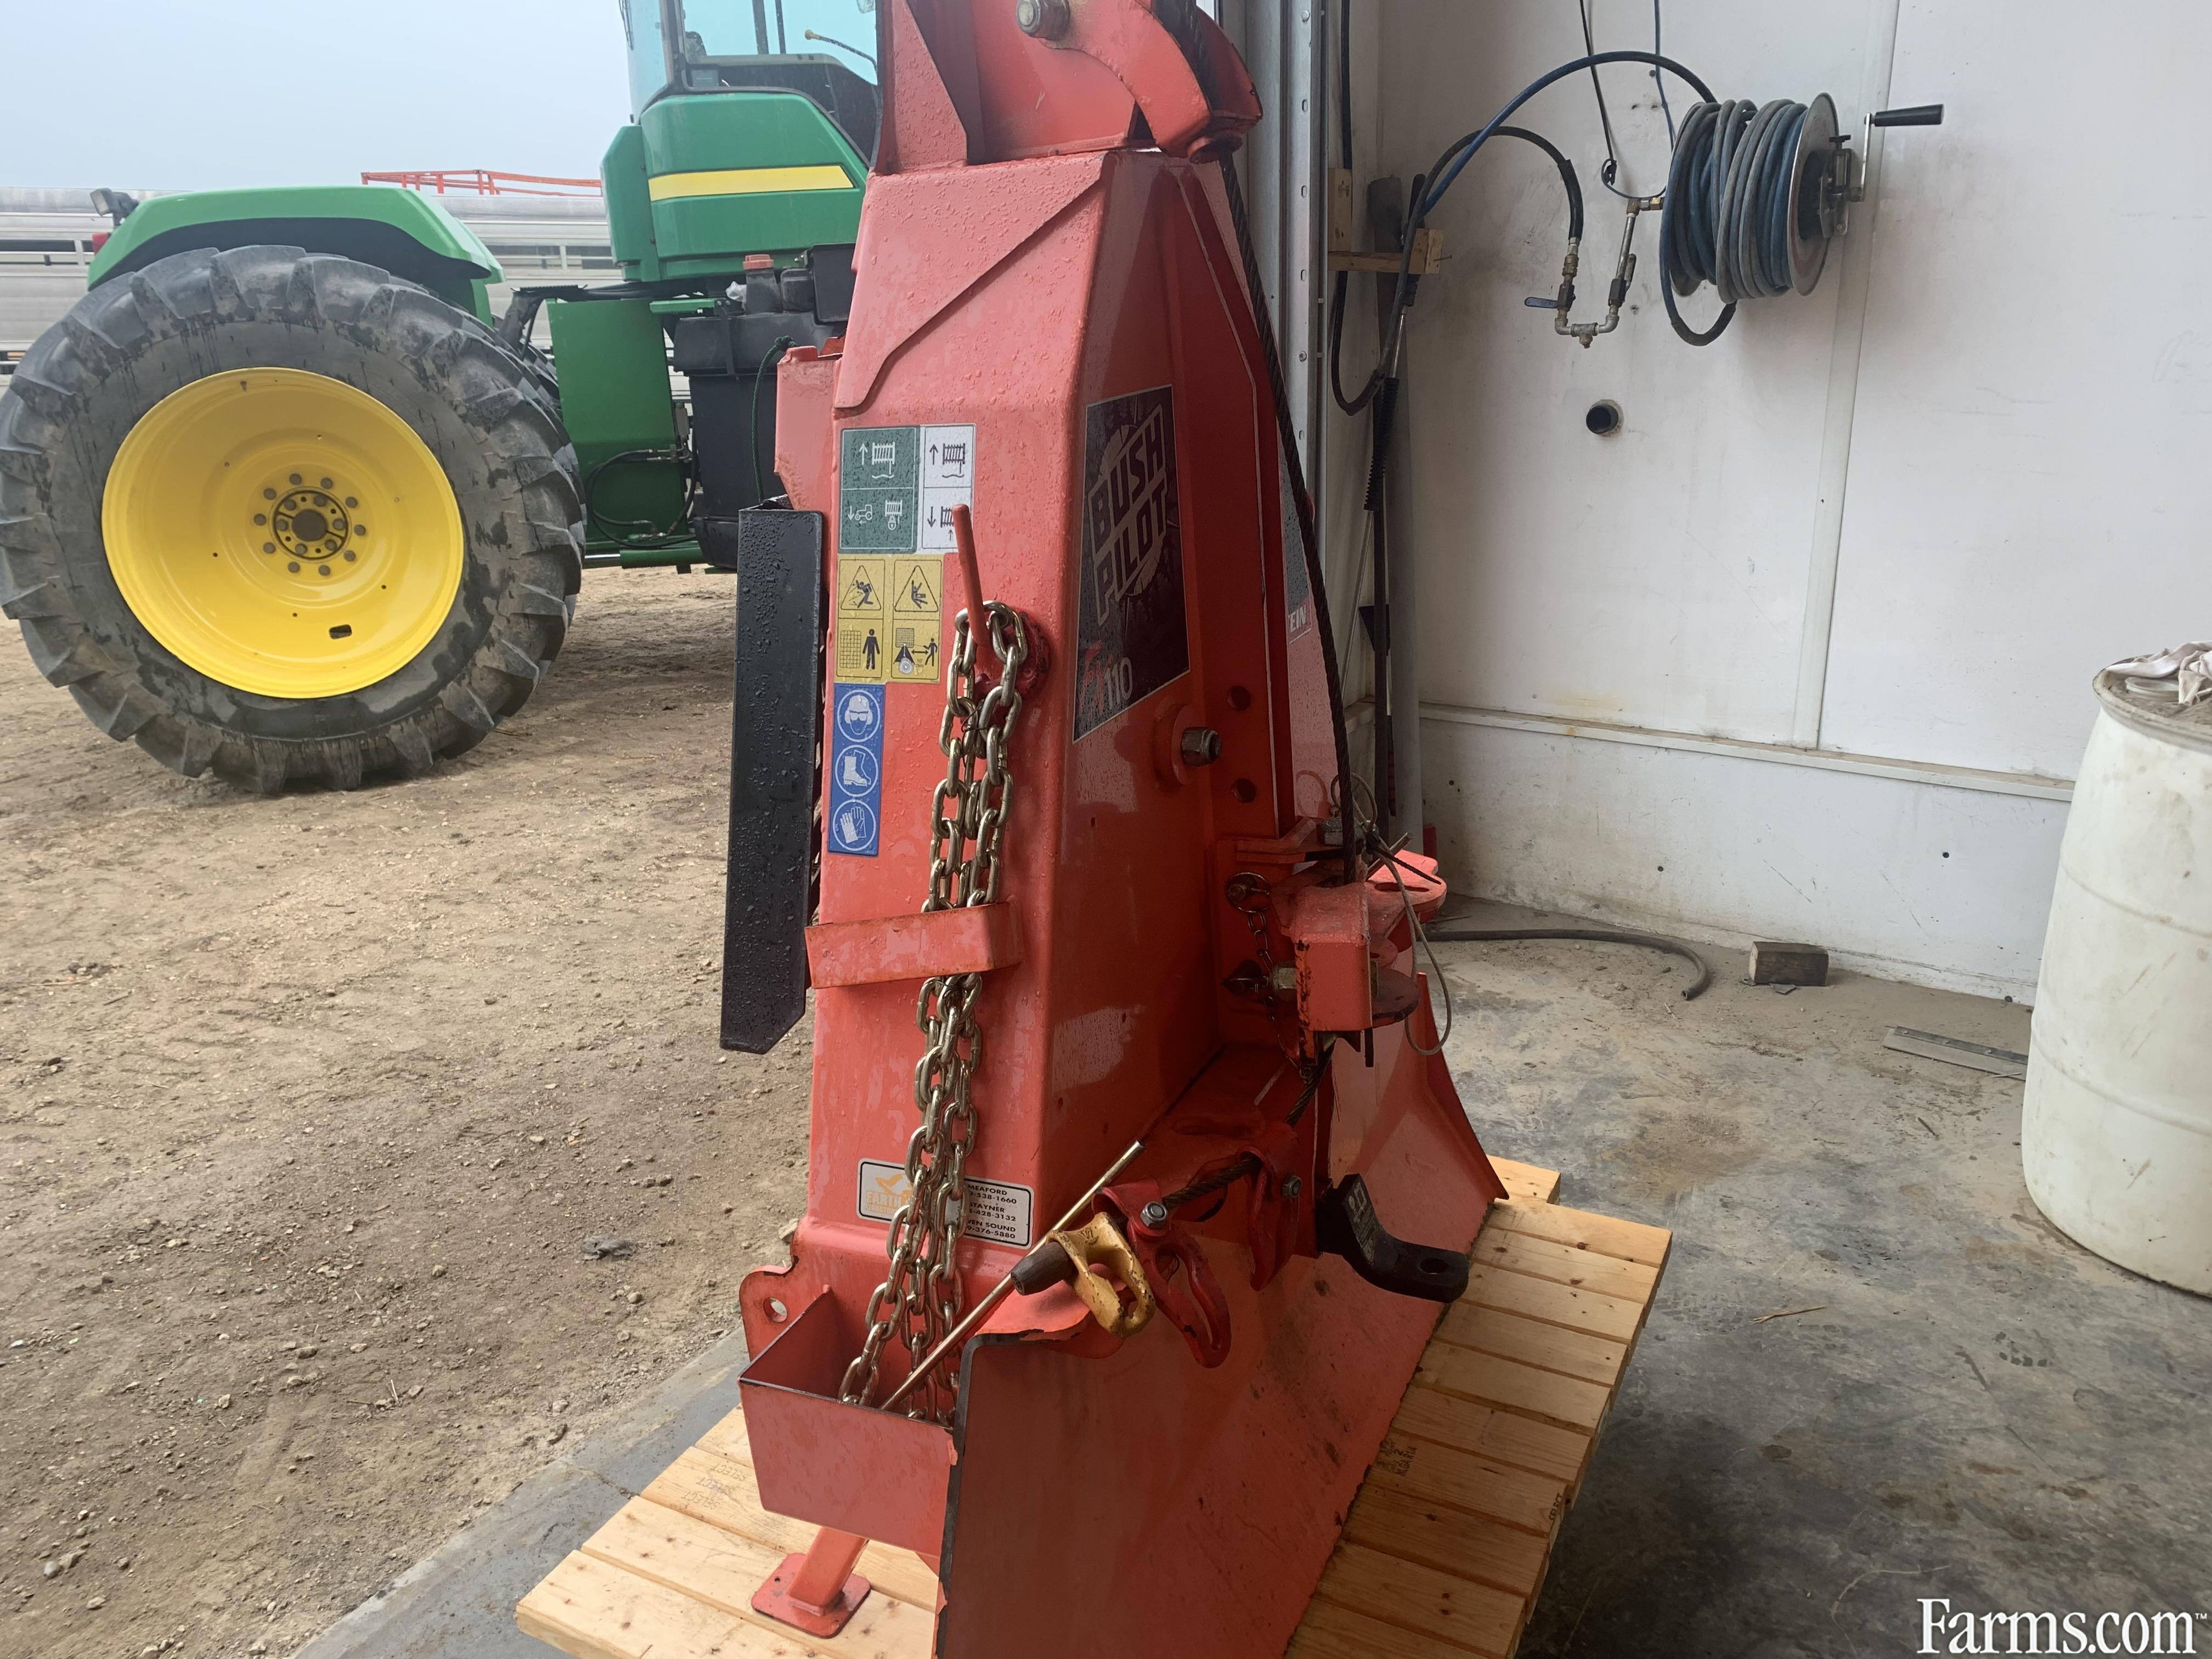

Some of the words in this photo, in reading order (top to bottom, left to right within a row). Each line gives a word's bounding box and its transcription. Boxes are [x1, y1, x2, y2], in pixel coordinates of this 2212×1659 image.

[1090, 409, 1165, 555] BUSH
[1094, 475, 1167, 623] PILOT
[968, 1184, 1007, 1195] MEAFORD
[967, 1225, 1015, 1238] 9-376-5880
[985, 1222, 1016, 1232] SOUND
[710, 1463, 749, 1481] SELECT
[681, 1491, 720, 1510] SELECT
